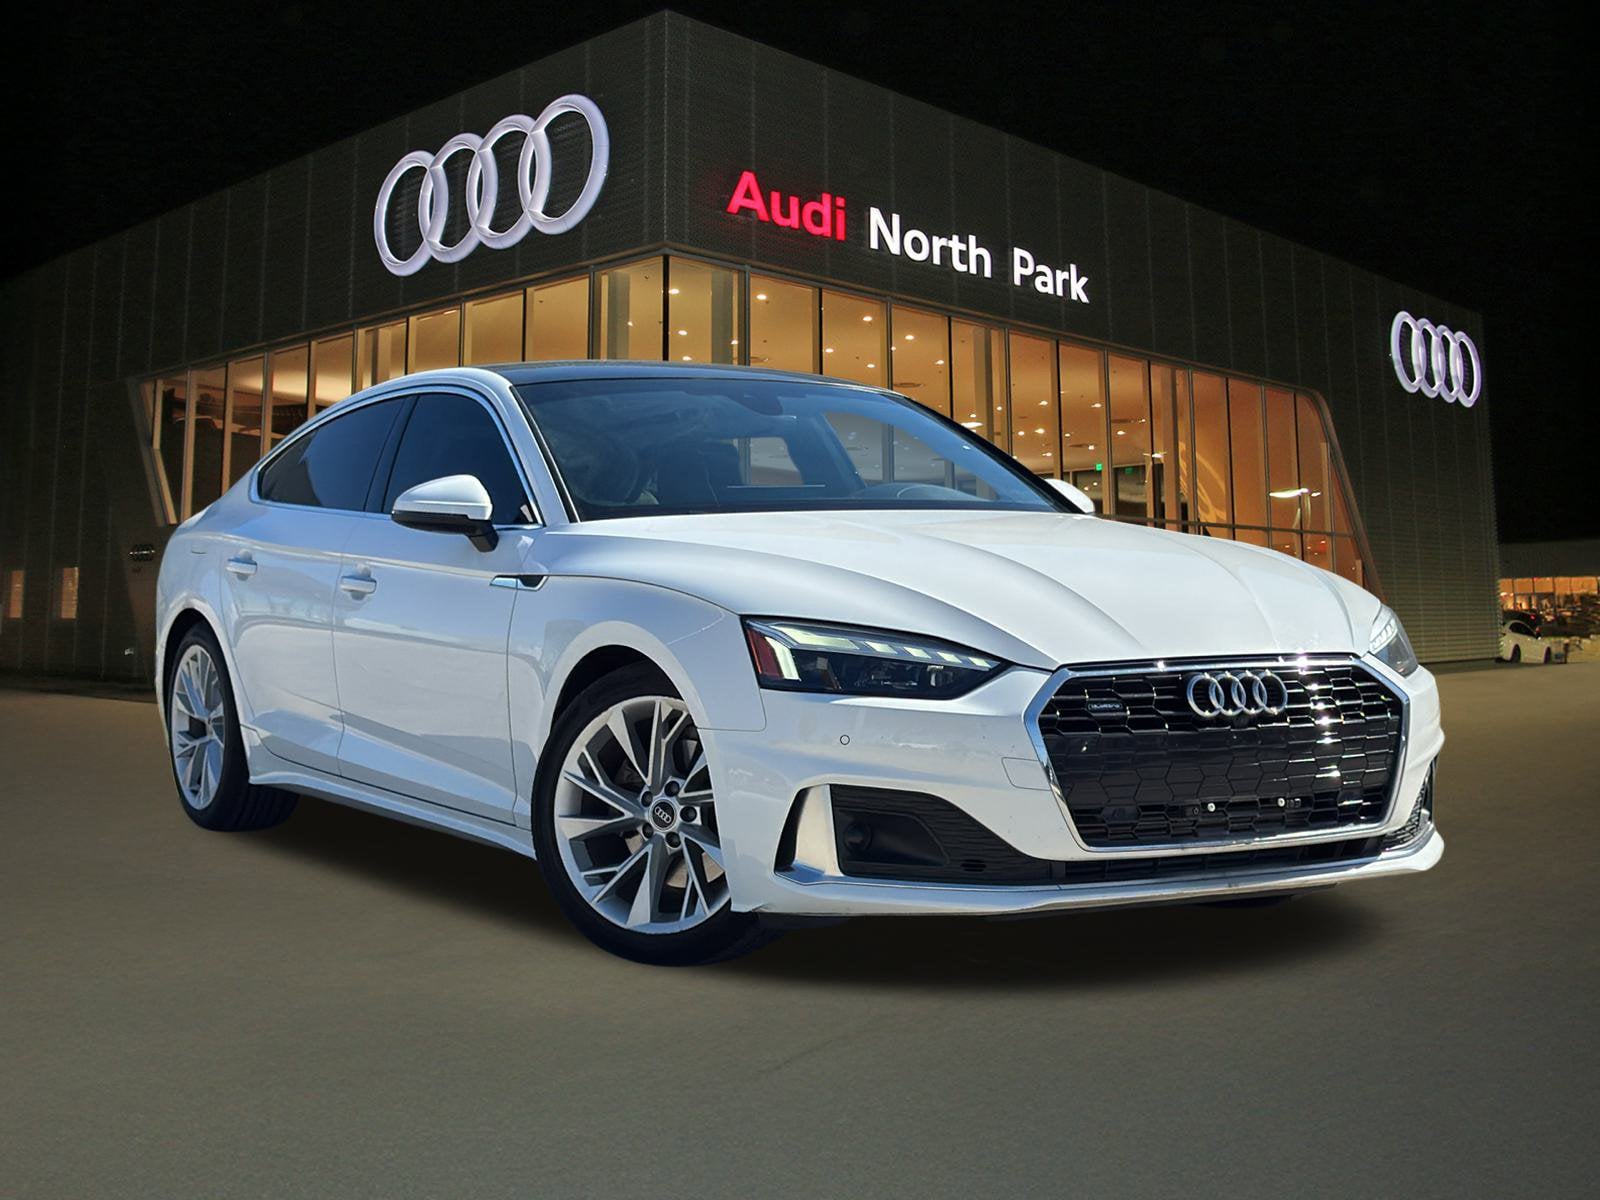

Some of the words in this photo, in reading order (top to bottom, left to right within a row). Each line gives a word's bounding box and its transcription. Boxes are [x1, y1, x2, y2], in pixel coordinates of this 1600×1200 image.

[726, 171, 847, 241] Audi
[869, 207, 992, 278] North
[1013, 247, 1089, 303] Park
